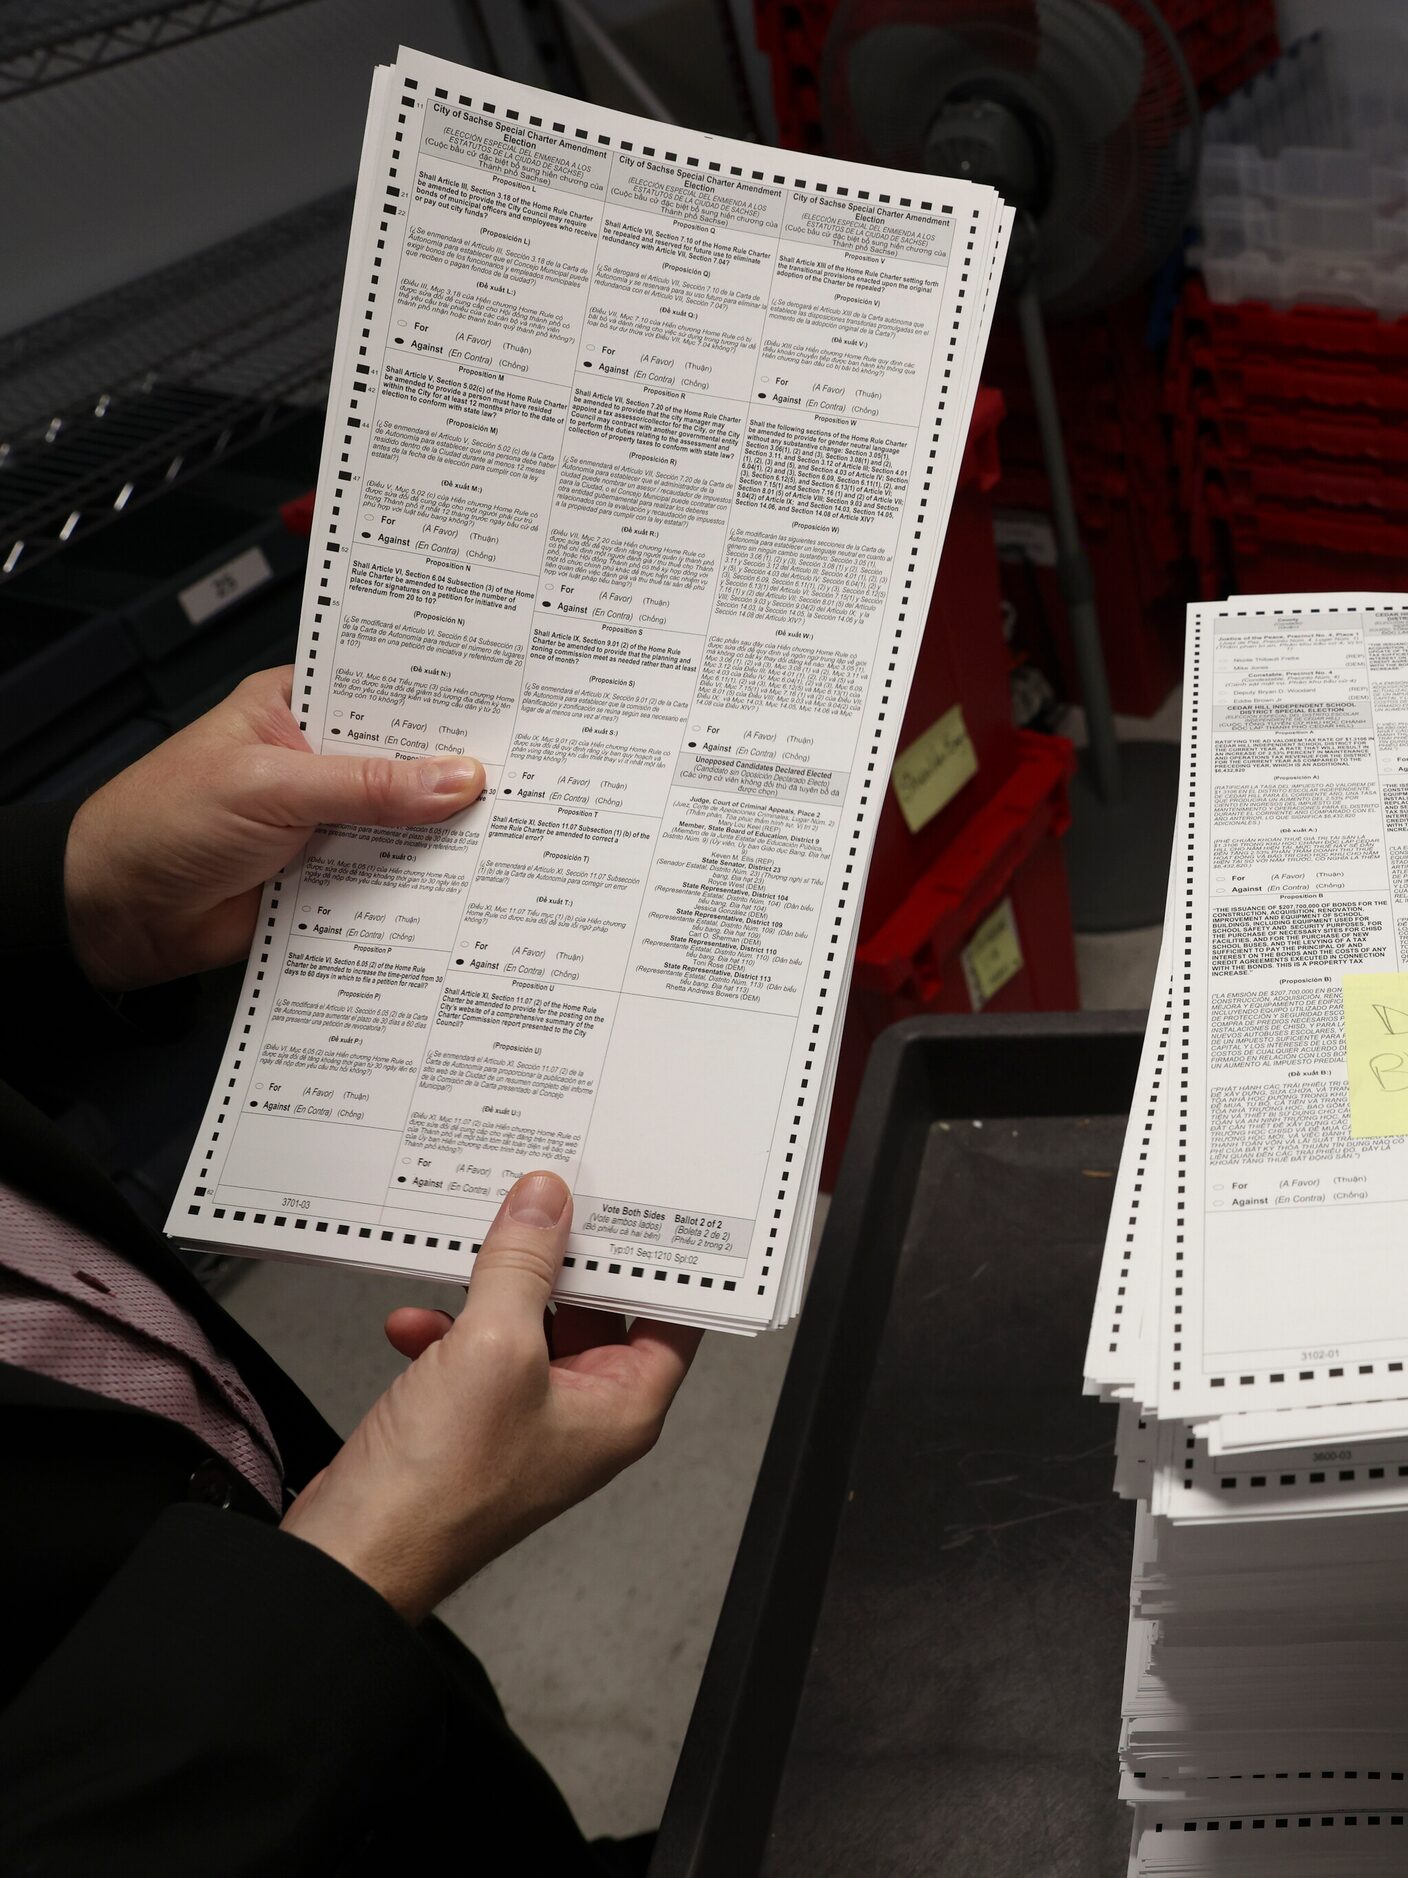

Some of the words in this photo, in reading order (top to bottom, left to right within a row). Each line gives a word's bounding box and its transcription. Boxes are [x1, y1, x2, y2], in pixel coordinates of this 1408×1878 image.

[433, 102, 451, 117] City
[452, 110, 462, 119] of
[462, 111, 494, 128] Sachse
[494, 121, 526, 137] Special
[526, 129, 558, 146] Charter
[558, 139, 607, 160] Amendment
[503, 133, 537, 150] Election
[492, 174, 532, 191] Proposition
[531, 183, 538, 193] L
[618, 155, 635, 168] City
[636, 160, 646, 169] of
[646, 161, 675, 176] Sachse
[676, 168, 705, 182] Special
[706, 175, 735, 188] Charter
[735, 181, 782, 198] Amendment
[683, 179, 716, 194] Election
[792, 192, 808, 204] City
[809, 196, 819, 204] of
[818, 197, 847, 209] Sachse
[847, 202, 876, 217] Special
[876, 207, 904, 219] Charter
[905, 212, 950, 227] Amendment
[672, 218, 709, 233] Proposition
[709, 224, 717, 235] Q
[854, 212, 886, 227] Election
[844, 251, 880, 264] Proposition
[880, 255, 887, 265] V
[413, 321, 429, 333] For
[455, 331, 465, 342] (A
[465, 333, 492, 349] Favor)
[410, 339, 444, 355] Against
[448, 348, 463, 358] (En
[463, 351, 493, 367] Contra)
[458, 363, 497, 380] Proposition
[497, 371, 506, 382] M
[642, 385, 681, 399] Proposition
[680, 392, 686, 400] R
[775, 376, 789, 386] For
[811, 383, 821, 392] (A
[821, 384, 846, 397] Favor)
[771, 393, 802, 405] Against
[805, 398, 819, 408] (En
[819, 400, 847, 413] Contra)
[814, 413, 850, 426] Proposition
[850, 417, 858, 427] W
[425, 557, 465, 571] Proposition
[465, 564, 472, 572] N
[601, 623, 638, 635] Proposition
[638, 628, 644, 636] S
[695, 755, 735, 767] Unopposed
[735, 760, 774, 772] Candidates
[774, 765, 806, 776] Declared
[806, 769, 833, 780] Elected
[557, 806, 593, 818] Proposition
[1231, 1181, 1248, 1190] For
[1279, 1179, 1290, 1190] (A
[1291, 1178, 1321, 1188] Favor)
[281, 1197, 311, 1210] 3701-03
[1231, 1196, 1269, 1208] Against
[1274, 1195, 1291, 1206] (En
[1292, 1193, 1326, 1203] Contra)
[602, 1203, 621, 1215] Vote
[621, 1206, 642, 1217] Both
[643, 1209, 666, 1221] Sides
[674, 1213, 699, 1226] Ballot
[699, 1217, 706, 1227] 2
[706, 1219, 717, 1228] of
[716, 1220, 723, 1230] 2
[609, 1243, 634, 1255] Typ:01
[636, 1247, 673, 1262] Seq:1210
[674, 1252, 699, 1266] Spl:02
